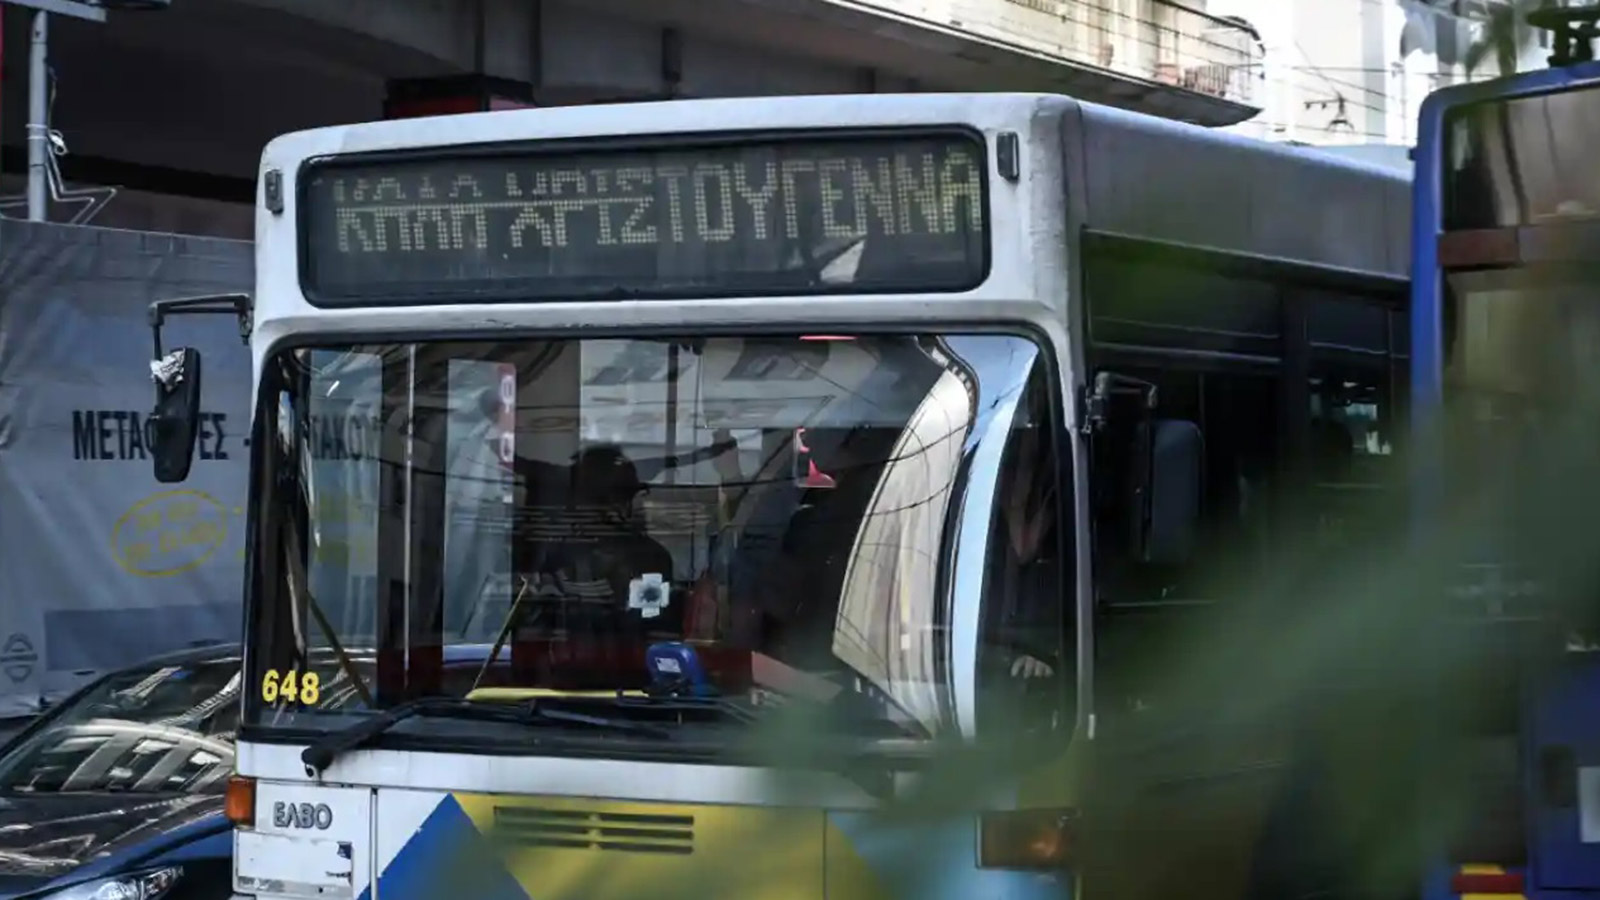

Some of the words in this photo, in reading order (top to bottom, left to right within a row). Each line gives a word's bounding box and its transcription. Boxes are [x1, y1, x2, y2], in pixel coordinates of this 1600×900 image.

[72, 410, 230, 461] ΜΕΤΑΕΣ
[262, 669, 320, 705] 648
[273, 801, 333, 830] ΕΛΒΟ
